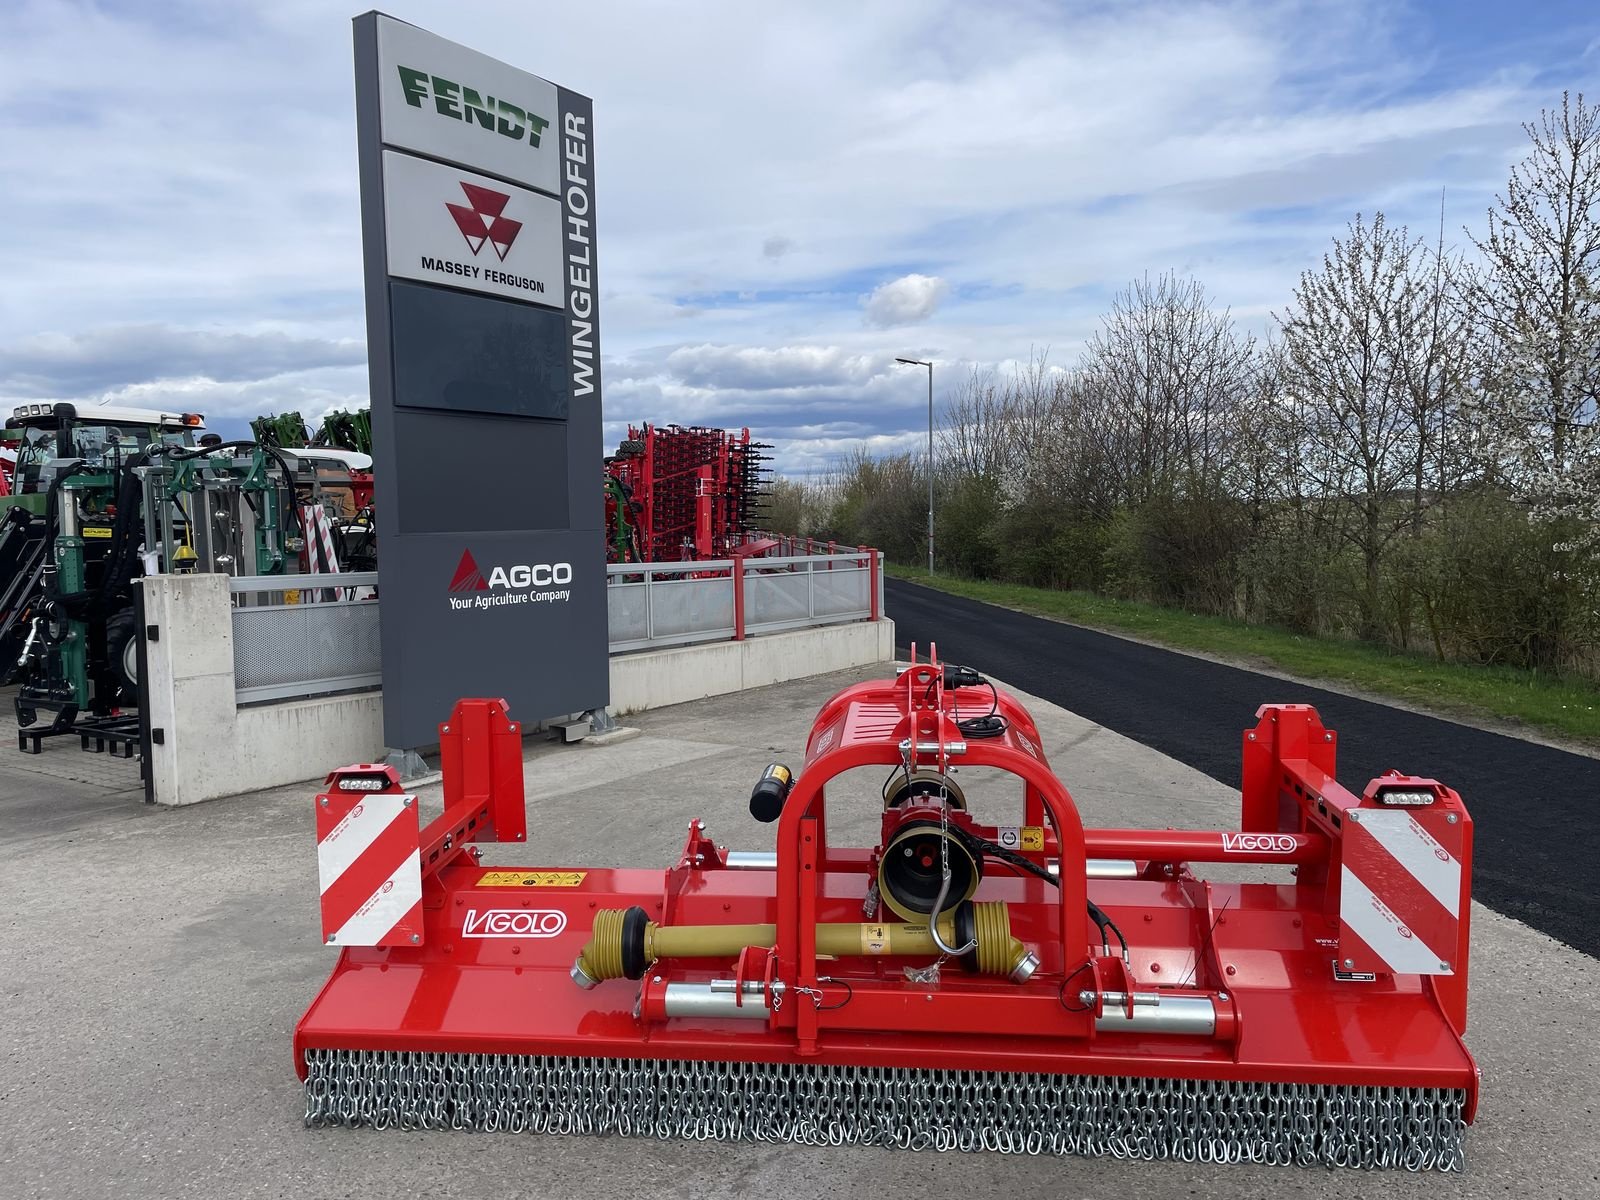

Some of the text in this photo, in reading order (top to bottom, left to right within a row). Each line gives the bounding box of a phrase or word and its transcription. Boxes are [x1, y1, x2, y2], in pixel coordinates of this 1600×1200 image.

[396, 65, 550, 149] FENDT
[564, 111, 595, 397] WINGELHOFER
[421, 256, 545, 294] MASSEY FERGUSON
[488, 562, 573, 590] AGCO
[449, 589, 571, 610] Your Agriculture Company
[1221, 833, 1298, 854] VIGOLO
[461, 909, 568, 938] VIGOLO
